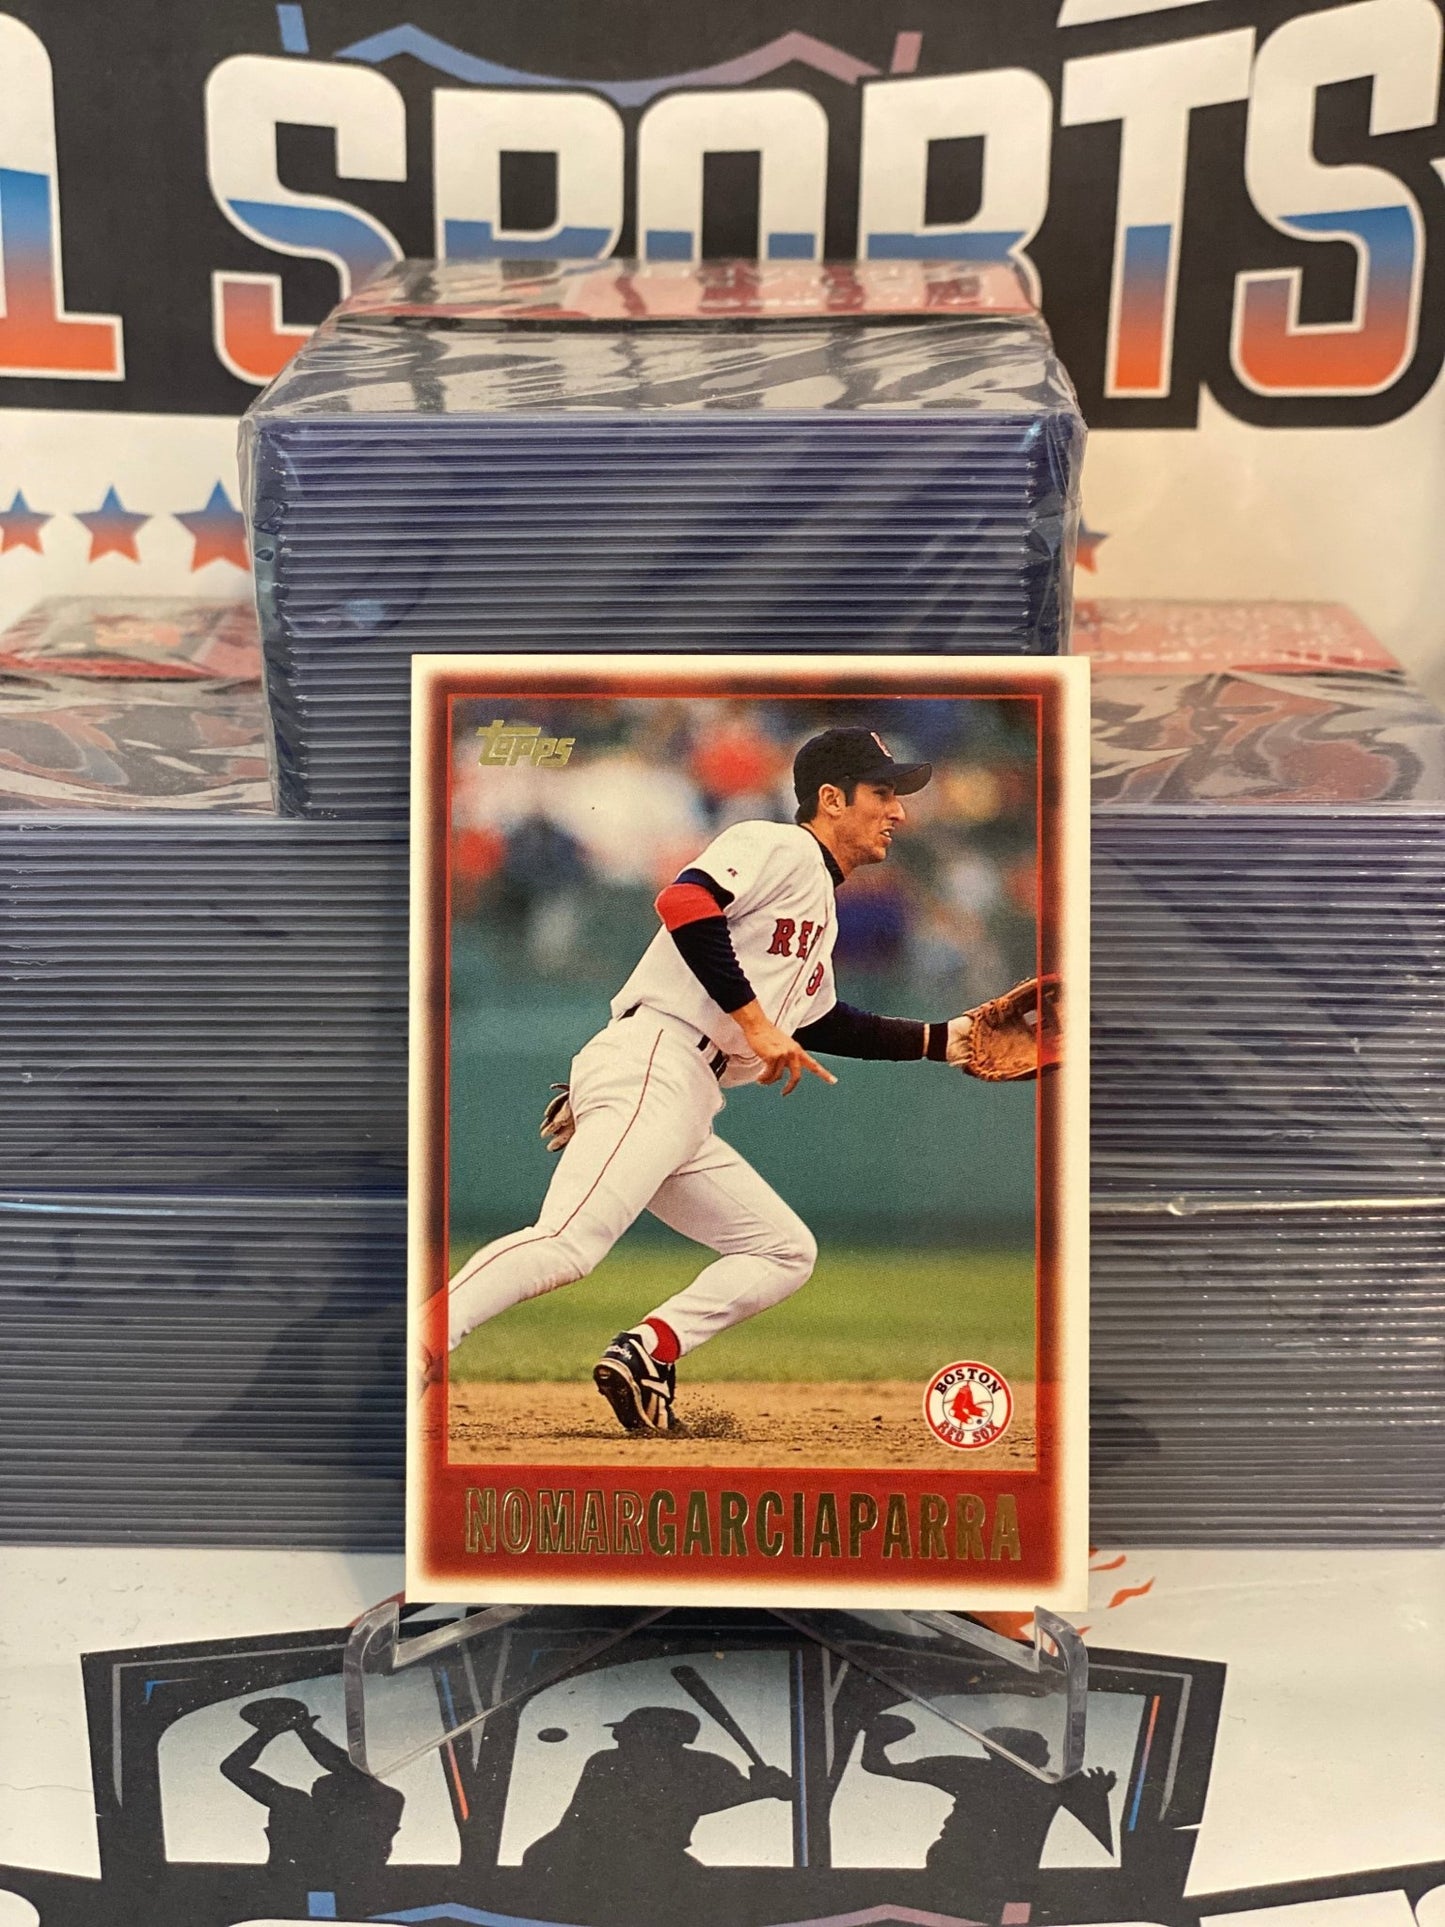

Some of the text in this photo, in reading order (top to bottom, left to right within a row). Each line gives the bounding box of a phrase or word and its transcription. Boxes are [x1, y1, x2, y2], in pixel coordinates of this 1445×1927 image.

[205, 0, 1443, 397] SPORTS
[934, 1368, 1002, 1395] BOSTON
[937, 1420, 1001, 1444] RED SOX
